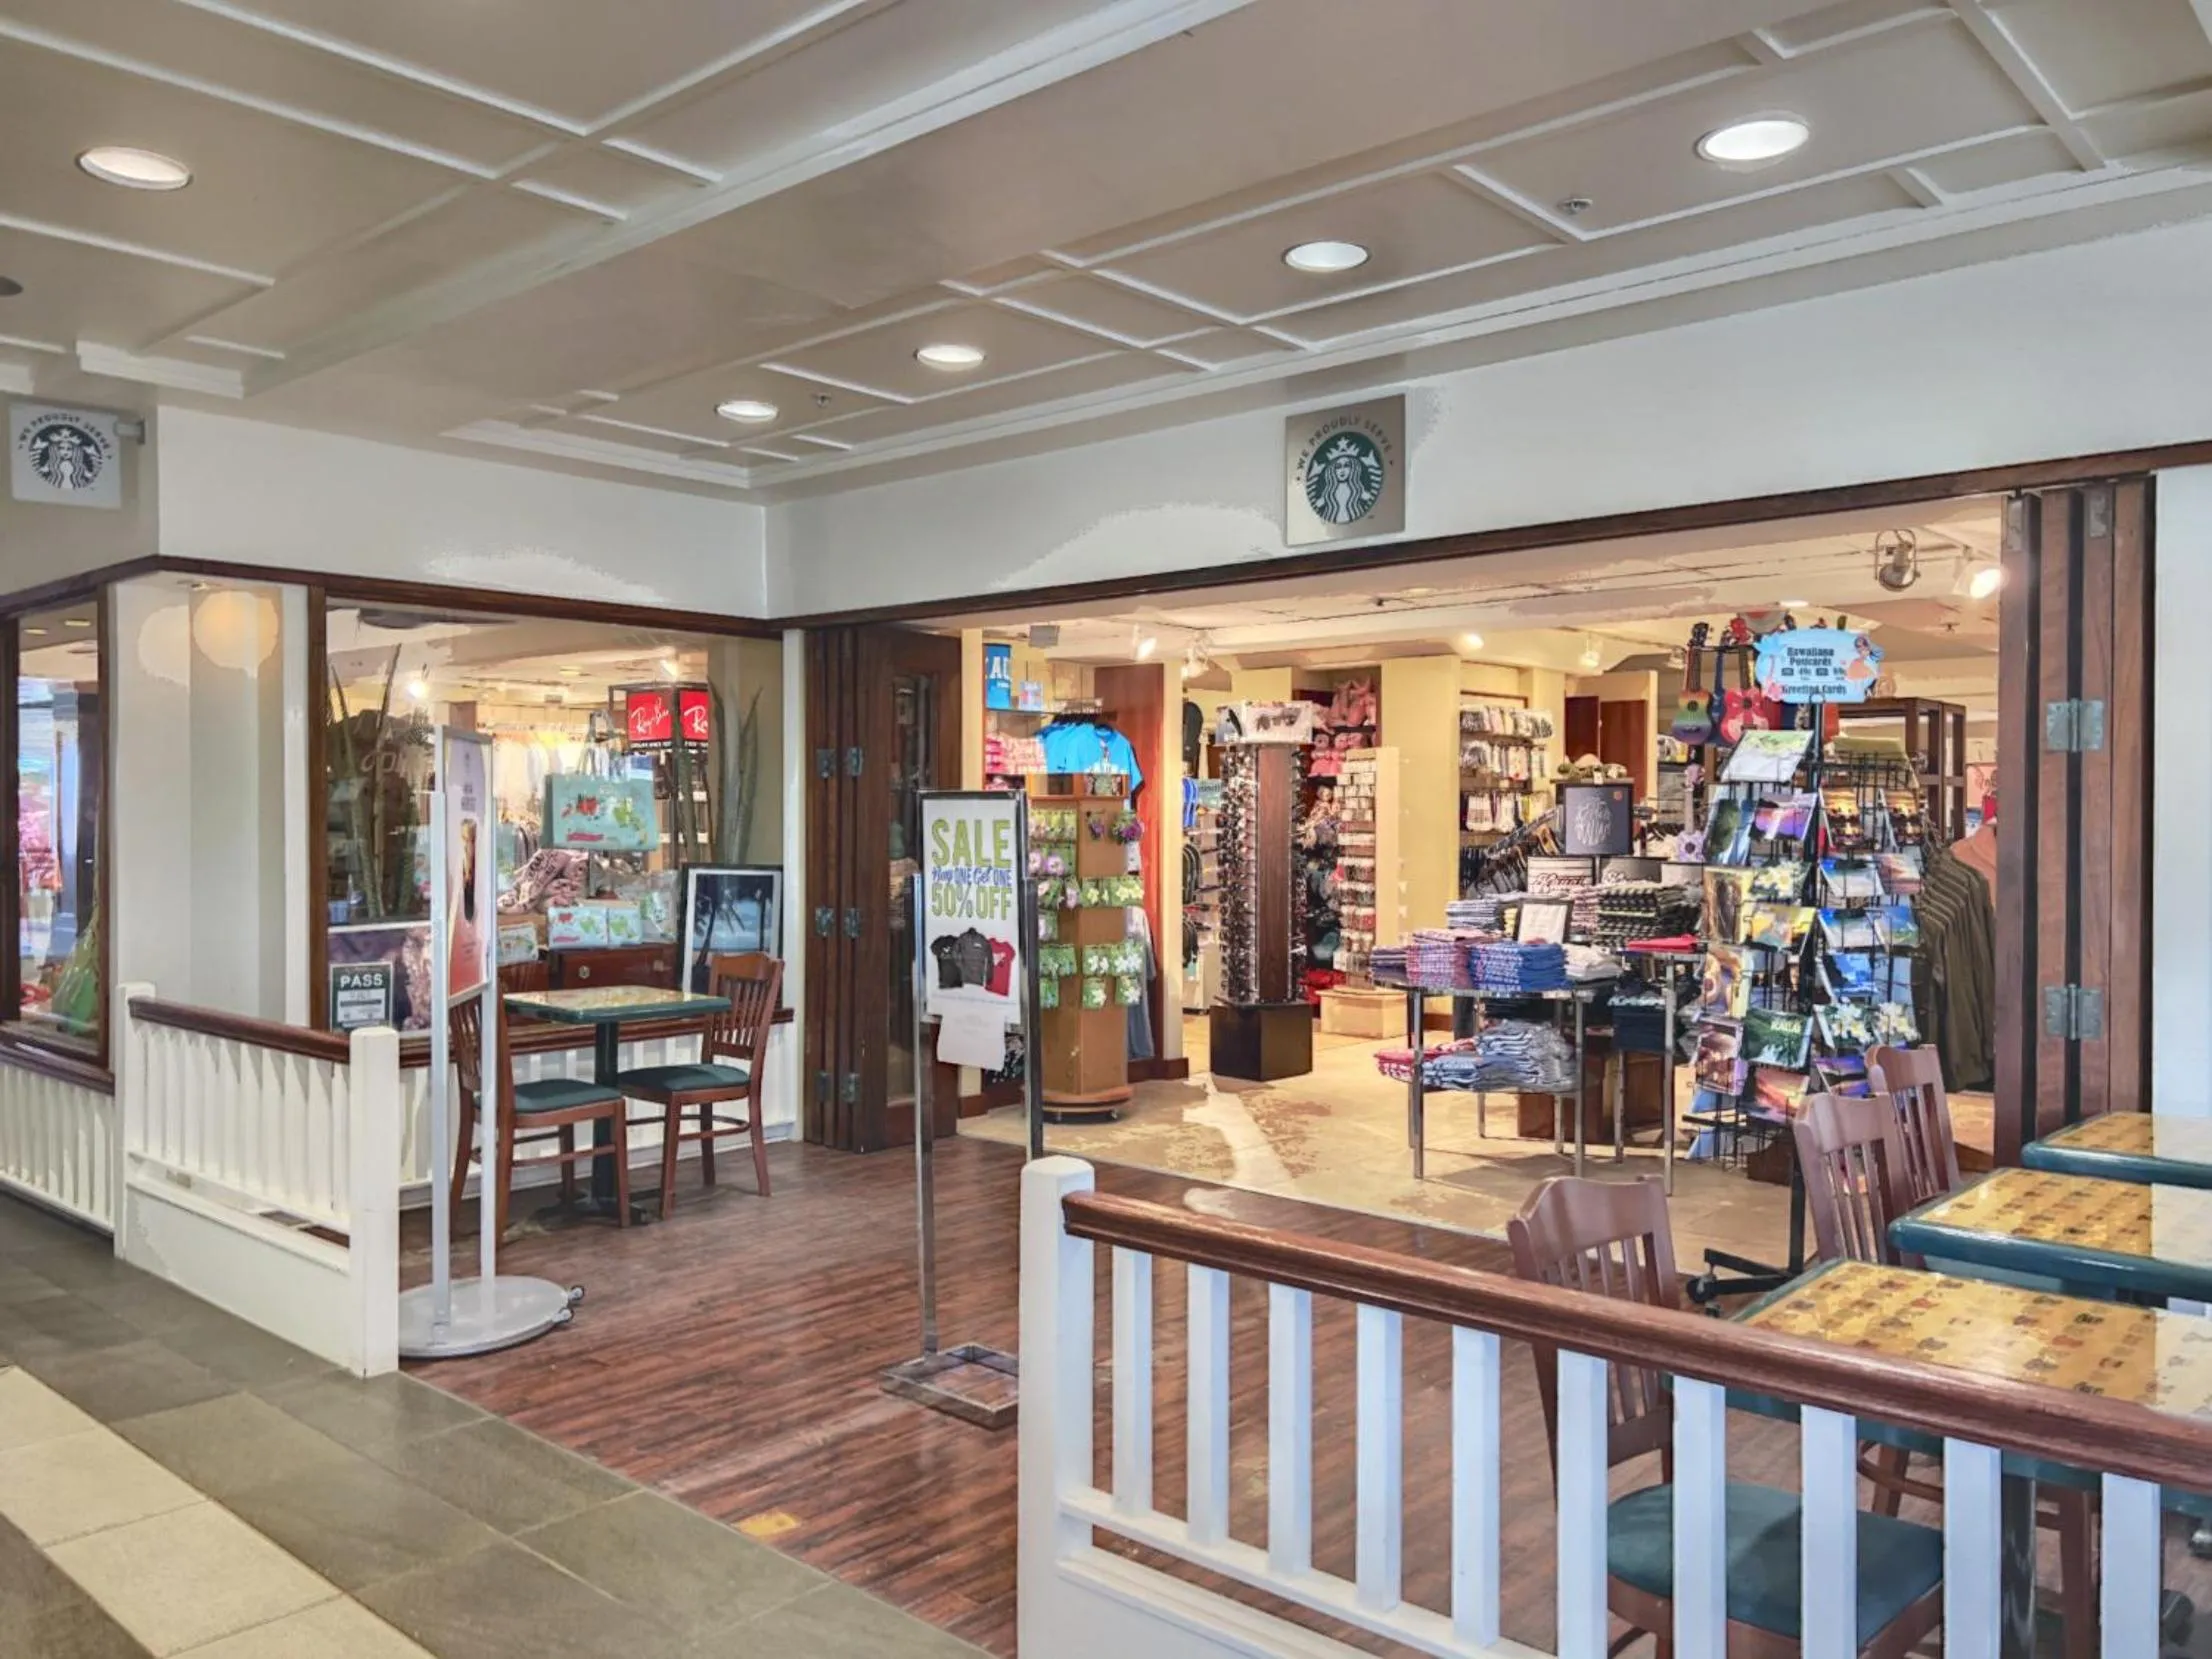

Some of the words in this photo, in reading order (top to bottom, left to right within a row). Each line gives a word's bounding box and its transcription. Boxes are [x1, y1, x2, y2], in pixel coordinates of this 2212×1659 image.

[1309, 415, 1361, 447] PROUDLY
[1364, 419, 1393, 453] SERVE
[931, 818, 1012, 868] SALE
[953, 867, 972, 885] ONE
[993, 869, 1013, 887] ONE
[931, 882, 973, 919] 50%
[975, 885, 1013, 921] OFF
[340, 973, 384, 989] PASS
